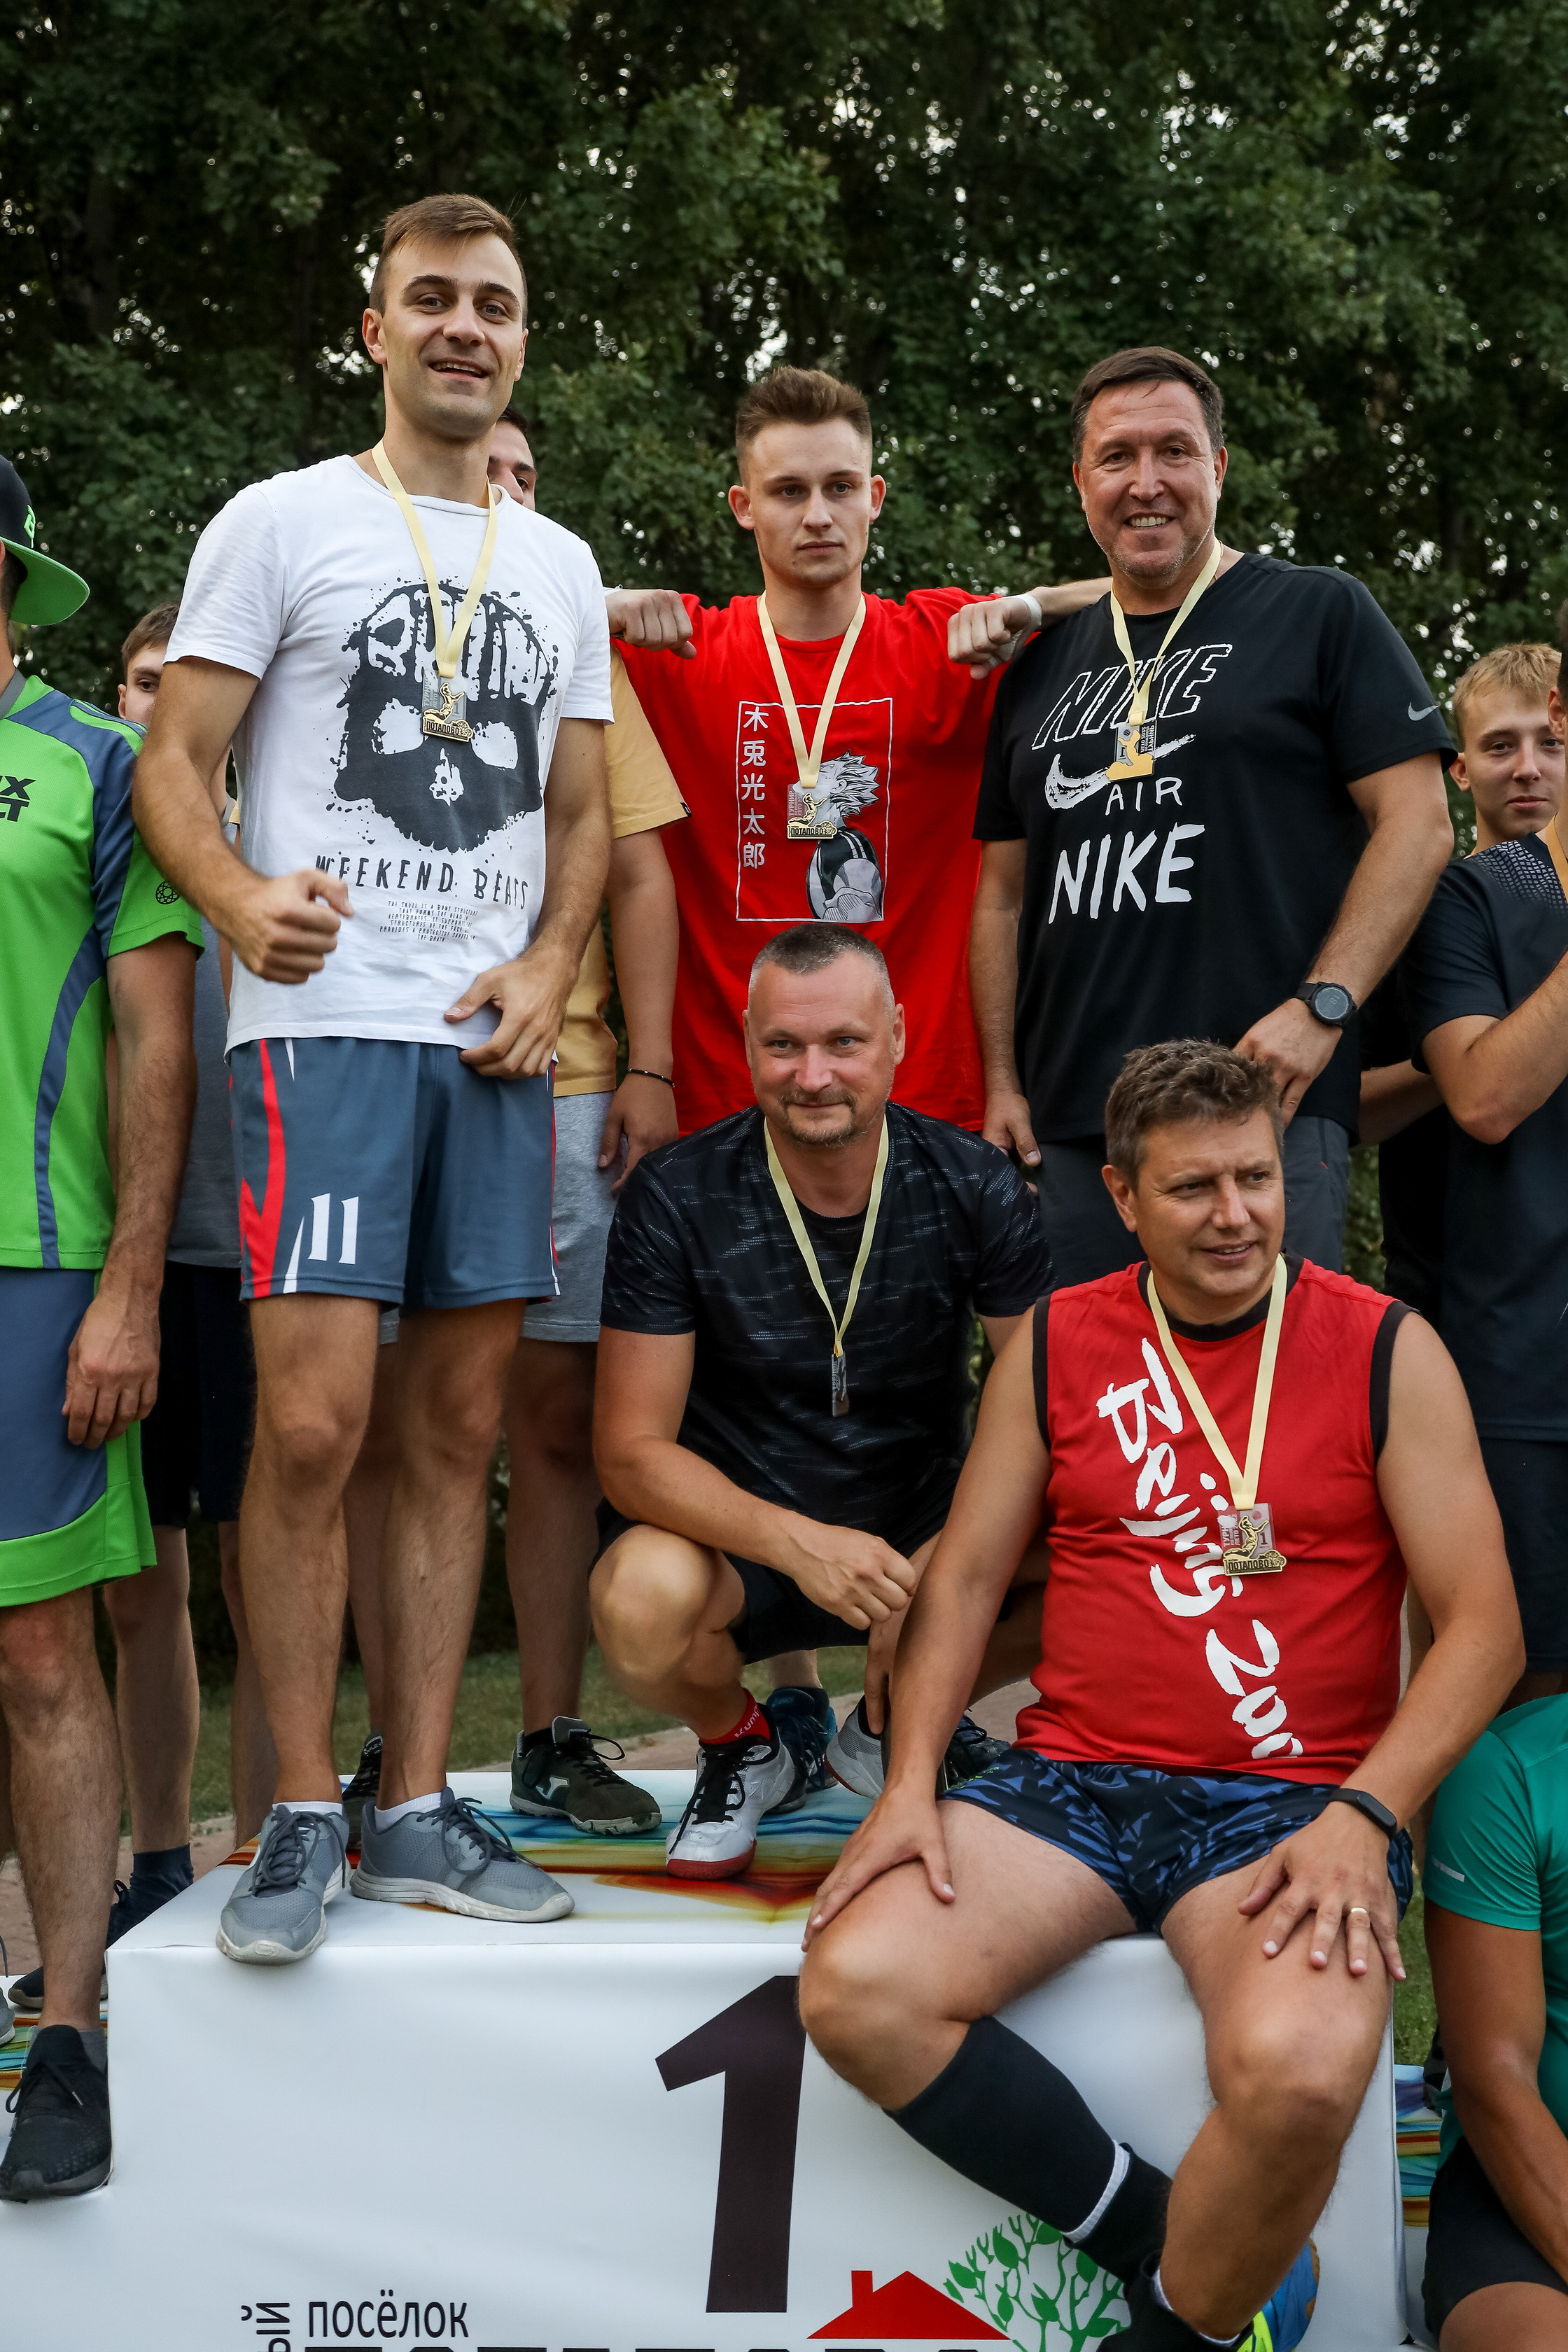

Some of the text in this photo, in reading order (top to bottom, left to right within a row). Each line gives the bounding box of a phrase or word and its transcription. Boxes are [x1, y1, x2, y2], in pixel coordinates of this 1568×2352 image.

[426, 721, 460, 735] ПОТАПОВО
[1105, 776, 1183, 816] AIR
[315, 855, 528, 910] WEEKEND BEATS
[1049, 822, 1205, 924] NIKE
[307, 1193, 359, 1265] 11
[1260, 1532, 1268, 1545] 1
[1228, 1559, 1269, 1571] ПОТАПОВО
[654, 1975, 808, 2314] 1
[308, 2288, 469, 2339] посёлок
